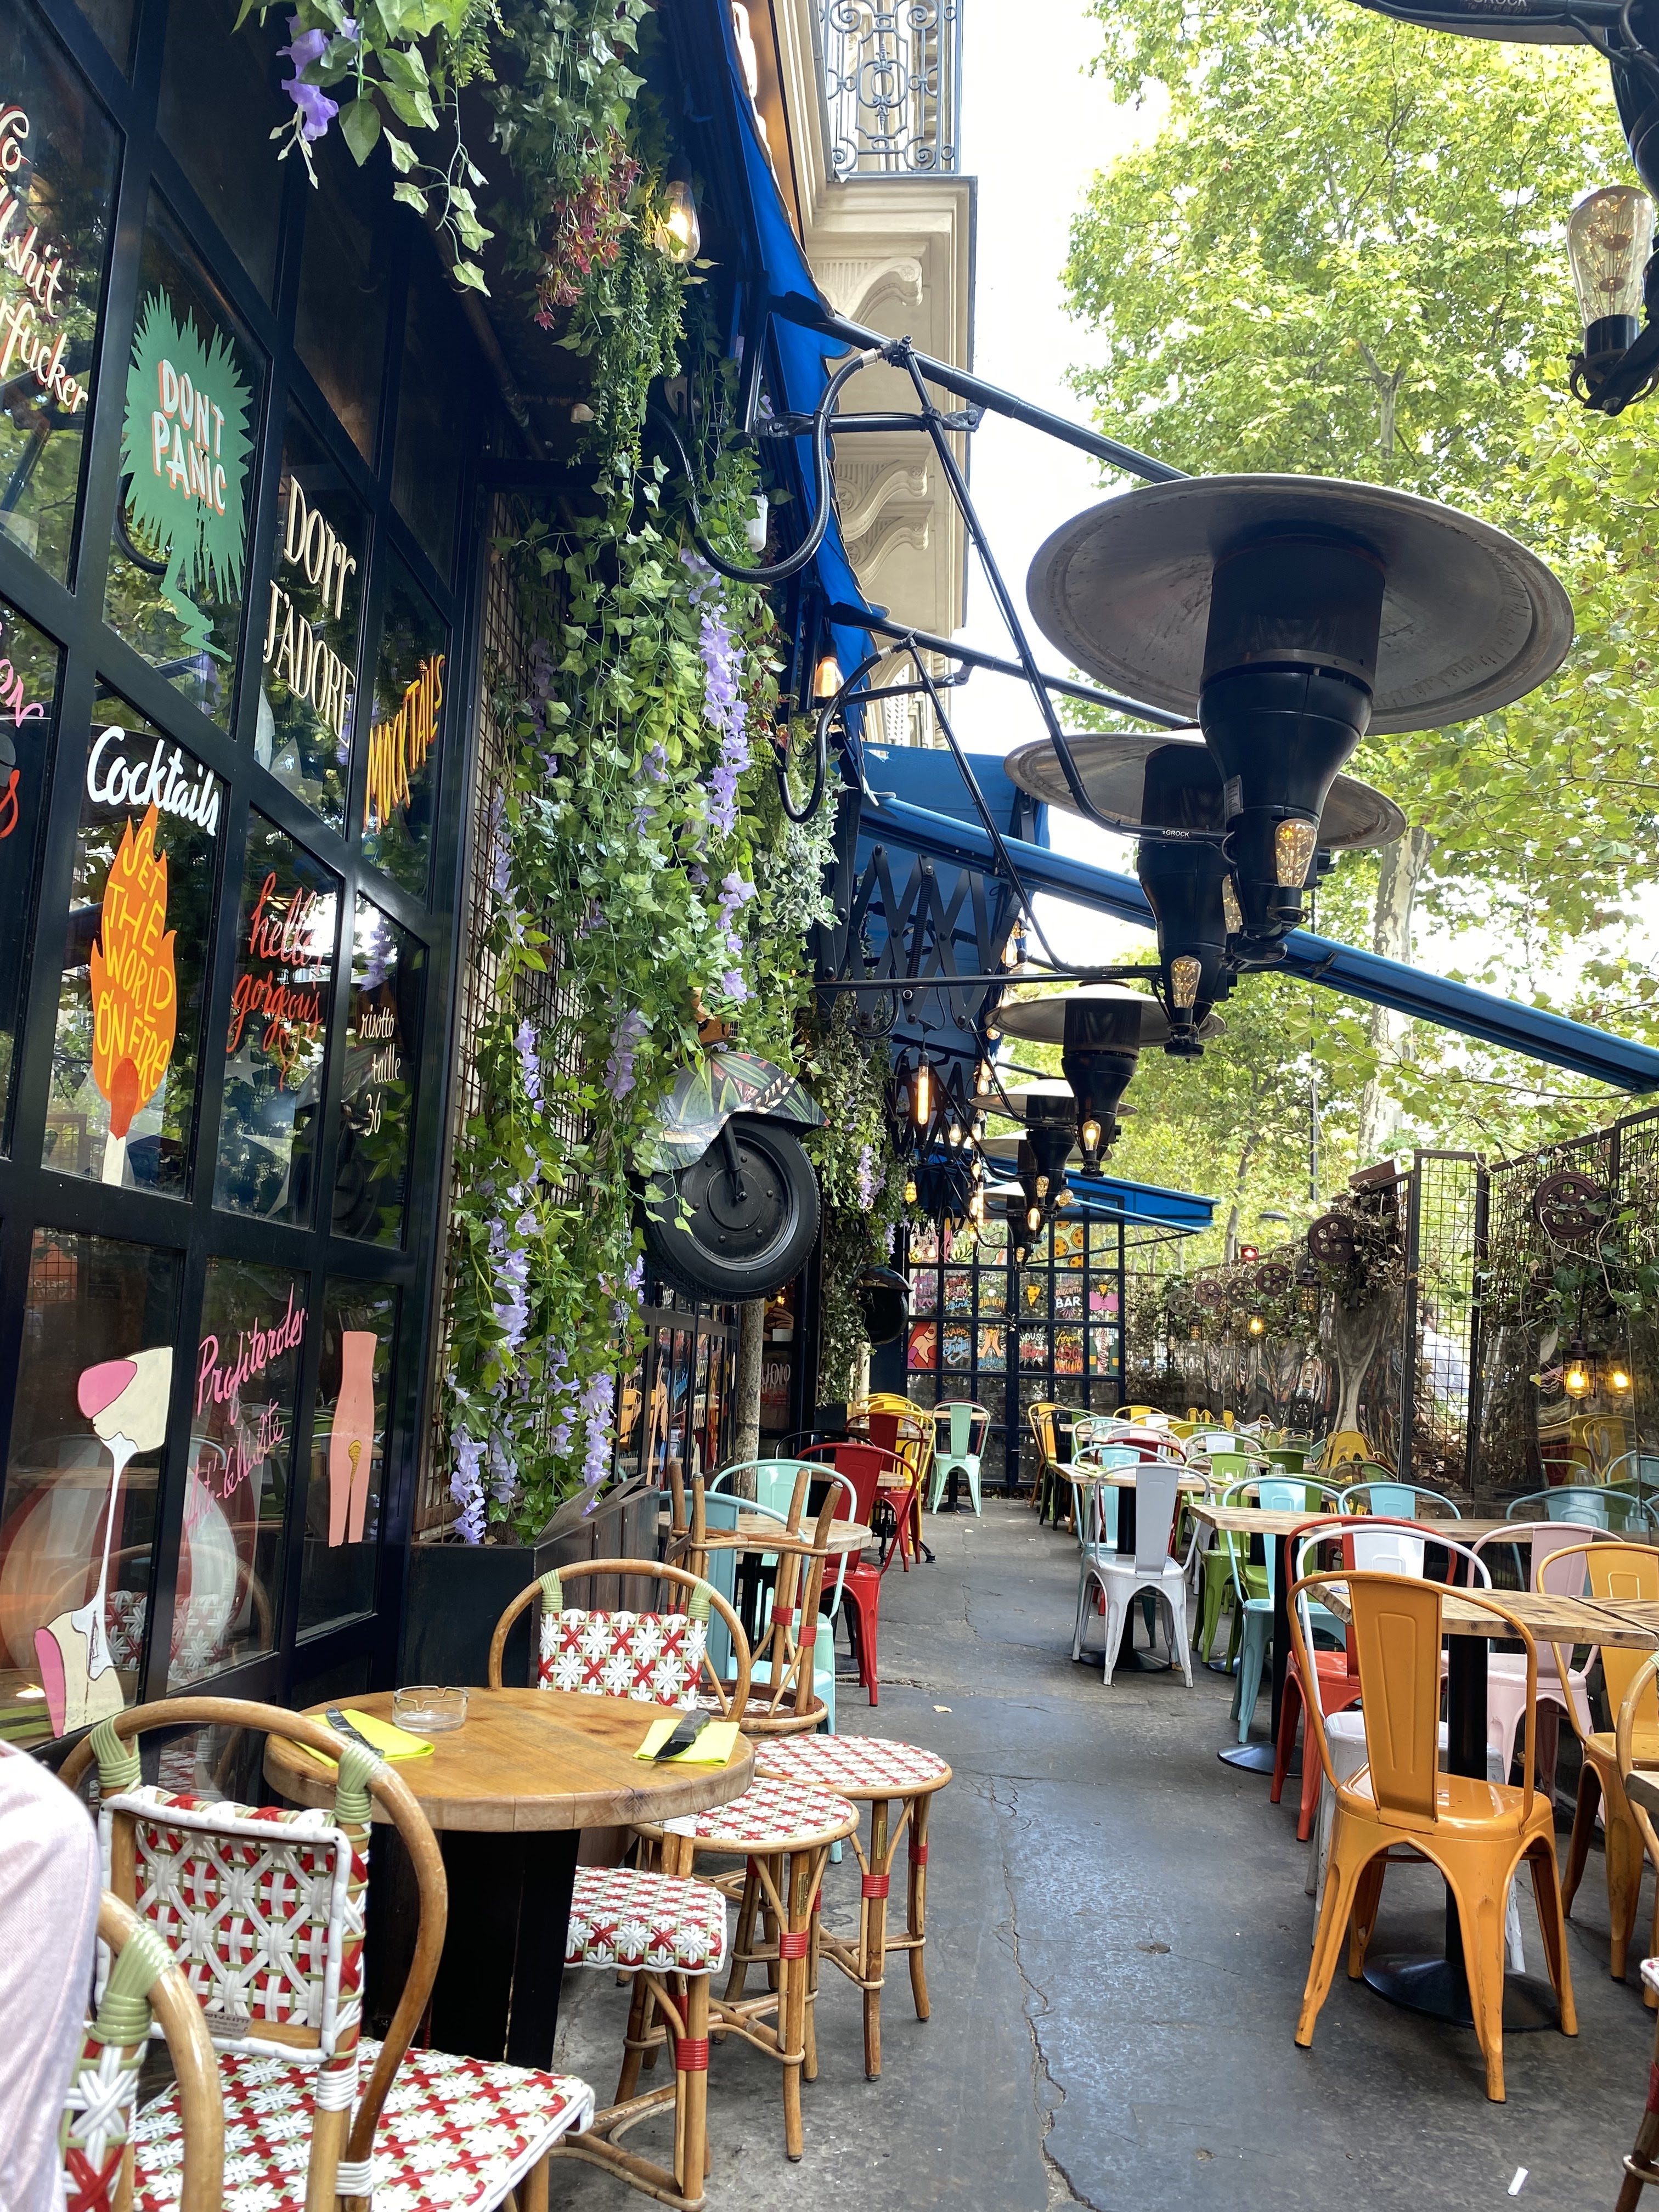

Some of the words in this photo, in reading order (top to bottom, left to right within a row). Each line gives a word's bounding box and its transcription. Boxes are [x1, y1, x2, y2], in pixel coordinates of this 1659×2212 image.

[158, 359, 224, 459] DONT
[151, 410, 227, 516] PANIC
[87, 725, 219, 837] Cocktails
[1165, 830, 1190, 839] GROCK
[121, 826, 166, 898] SET
[108, 881, 165, 957] THE
[104, 915, 174, 1024] WORLD
[96, 989, 128, 1089] ON
[359, 1004, 396, 1040] risotto
[371, 1043, 401, 1084] taille
[365, 1092, 382, 1137] 36
[1055, 1286, 1082, 1297] BRUSCHETTA
[1056, 1296, 1081, 1308] BAR
[943, 1327, 970, 1338] HAPPY
[1020, 1333, 1046, 1343] HOUSE
